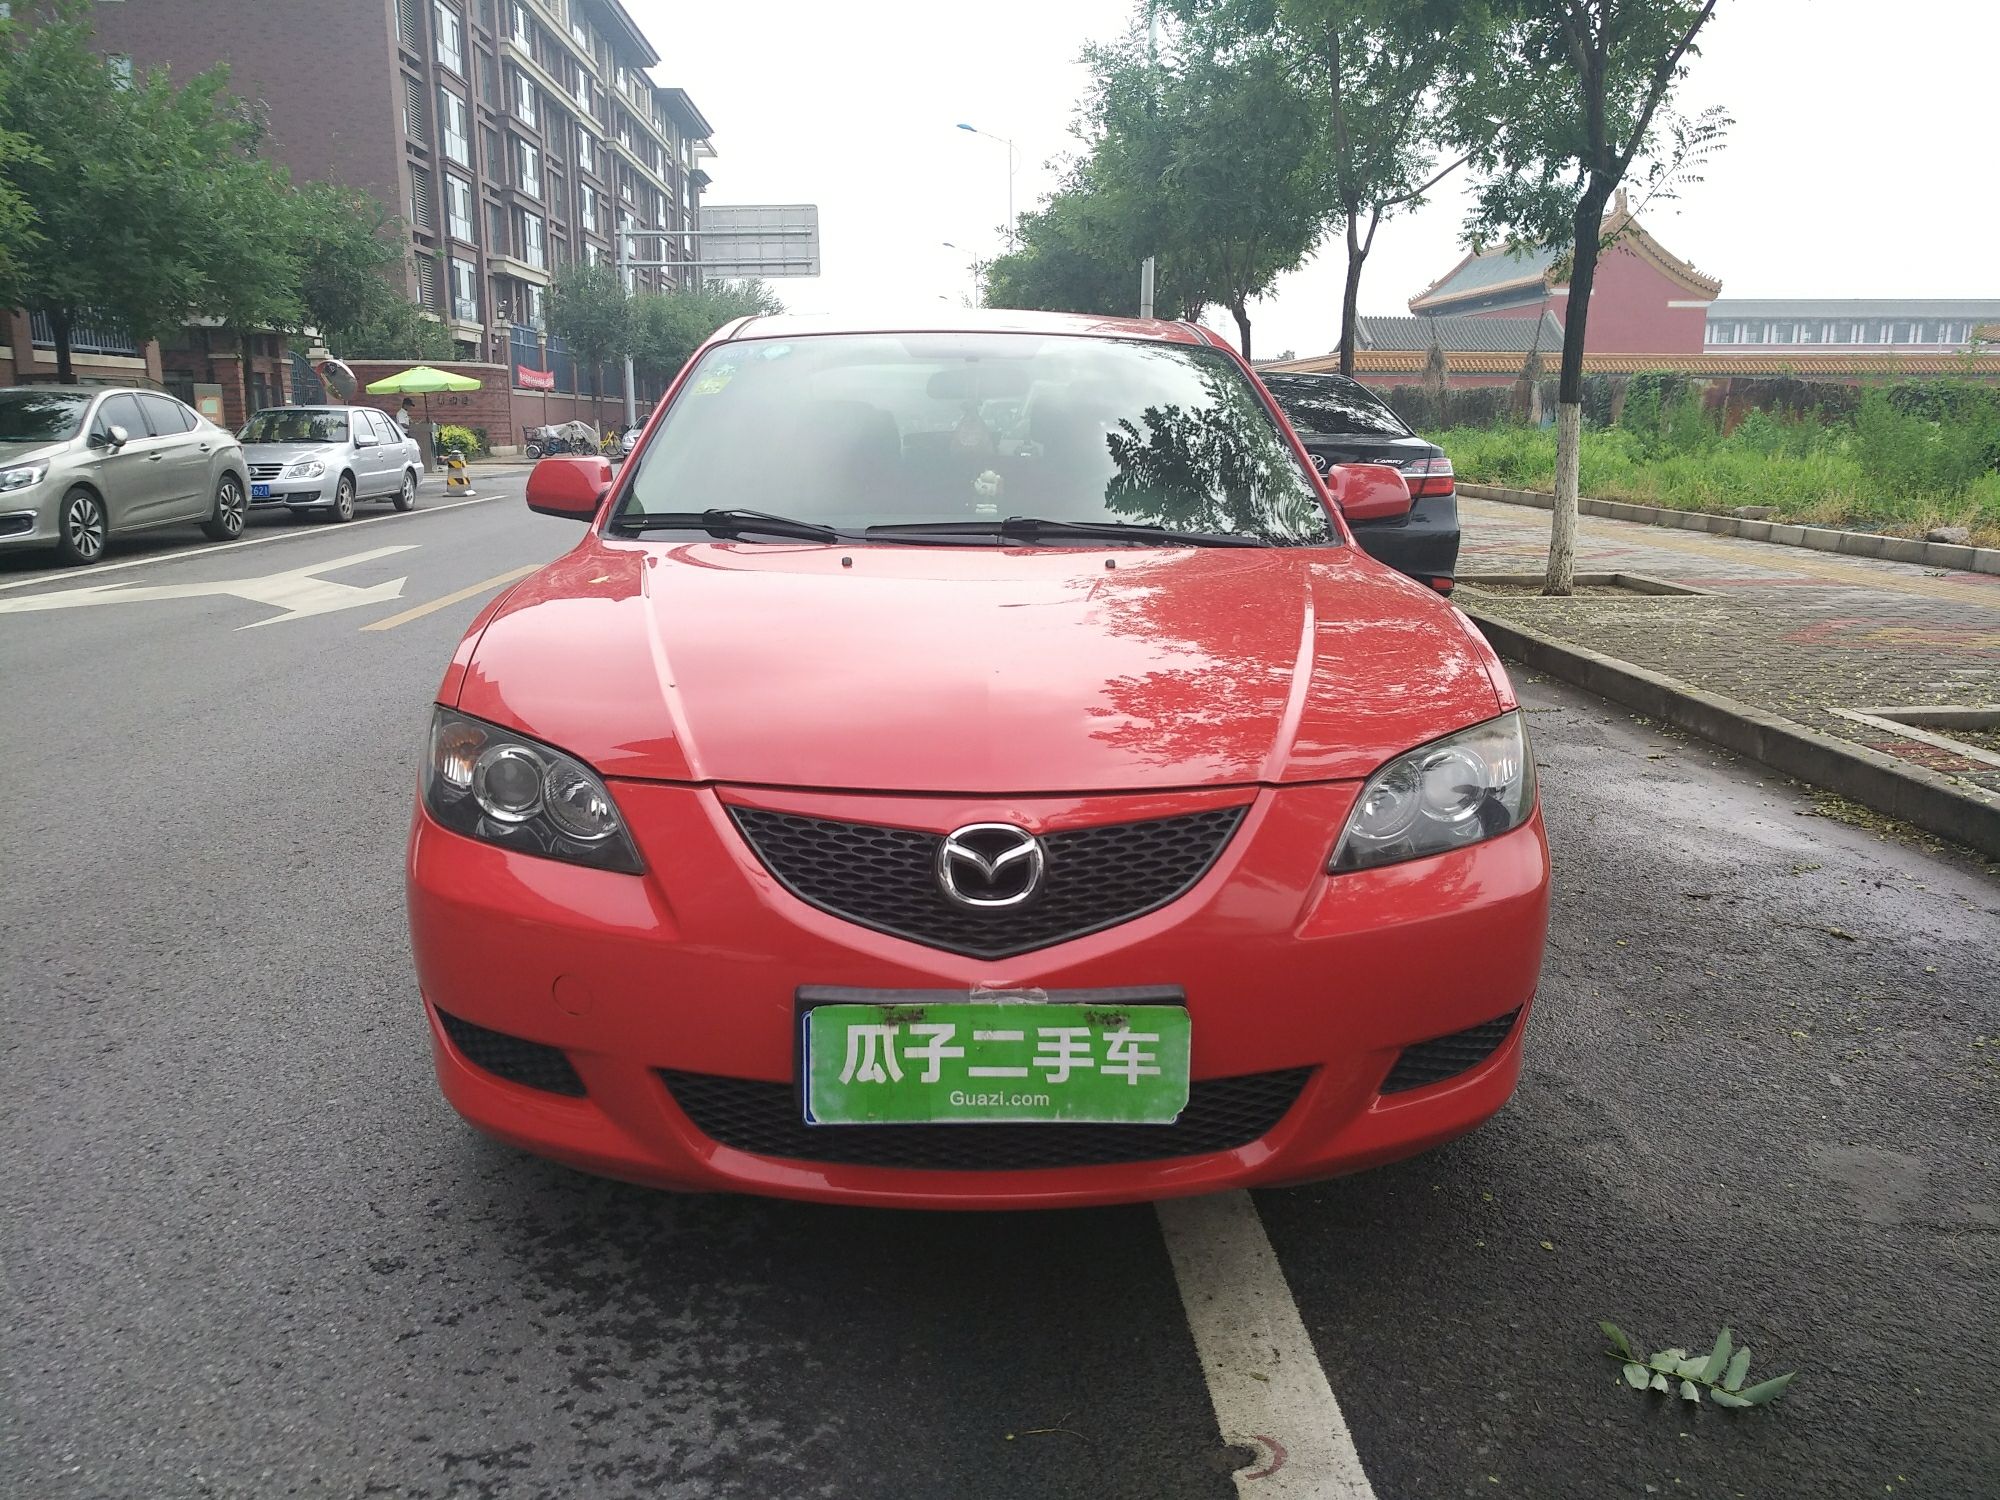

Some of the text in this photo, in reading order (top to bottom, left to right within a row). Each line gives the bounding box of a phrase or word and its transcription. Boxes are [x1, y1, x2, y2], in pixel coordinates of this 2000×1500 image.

[251, 486, 268, 496] 621
[838, 1023, 1161, 1085] 瓜子二手车
[949, 1090, 1050, 1107] Guazi.com
